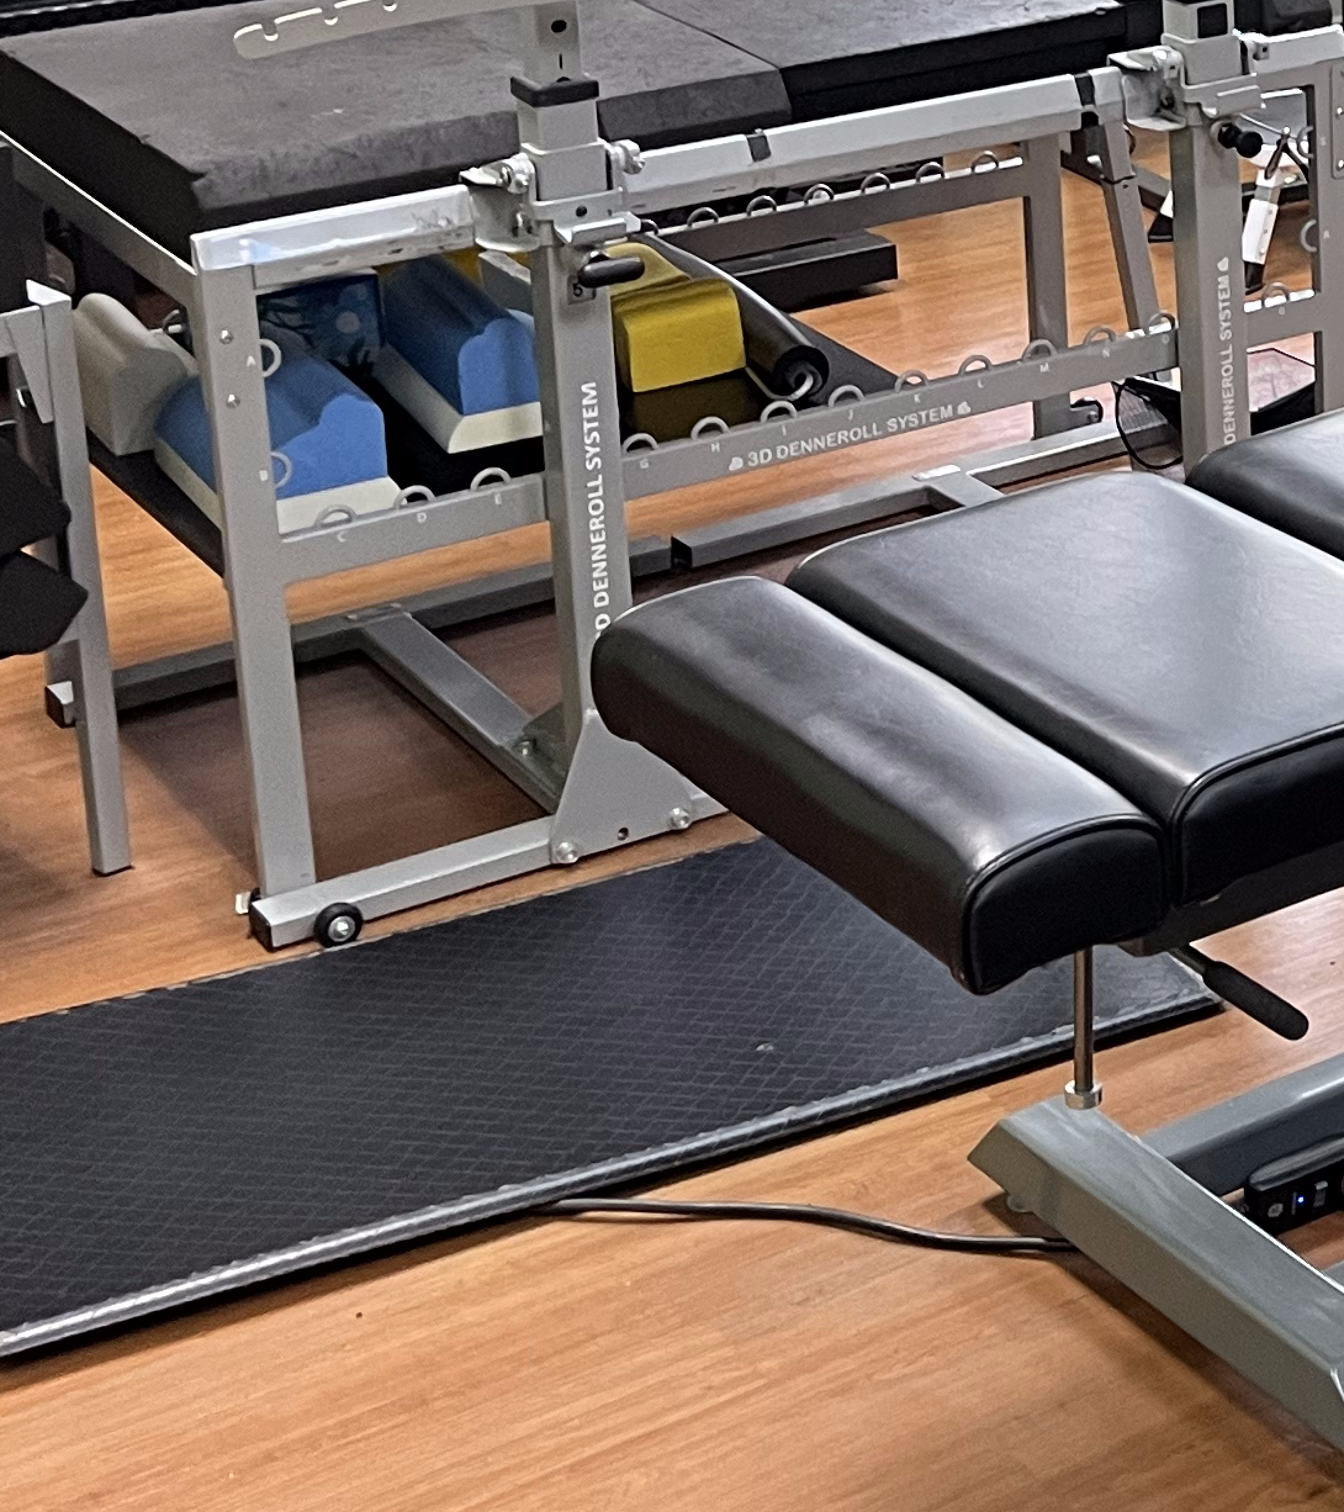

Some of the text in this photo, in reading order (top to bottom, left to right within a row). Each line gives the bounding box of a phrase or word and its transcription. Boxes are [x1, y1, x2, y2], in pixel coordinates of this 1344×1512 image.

[246, 355, 256, 367] A
[1039, 362, 1049, 373] M
[1217, 274, 1236, 446] DENNEROLL SYSTEM
[581, 381, 602, 471] SYSTEM
[747, 403, 954, 467] 3D DENNEROLL SYSTEM
[710, 442, 720, 453] H
[416, 511, 427, 524] D
[586, 474, 610, 609] DENNEROLL
